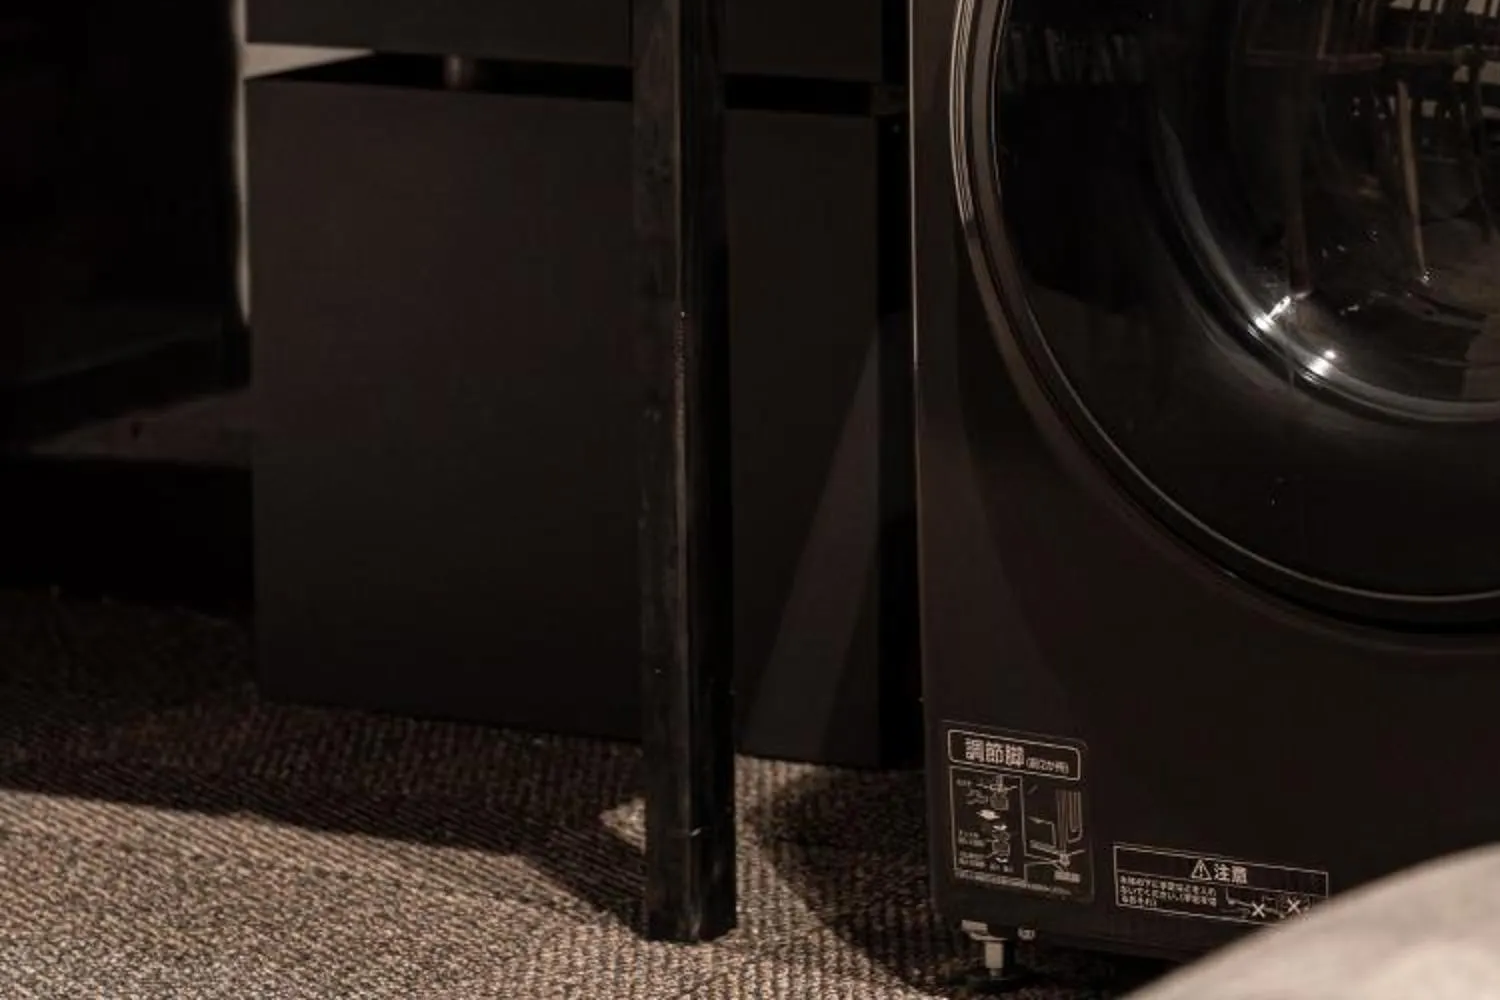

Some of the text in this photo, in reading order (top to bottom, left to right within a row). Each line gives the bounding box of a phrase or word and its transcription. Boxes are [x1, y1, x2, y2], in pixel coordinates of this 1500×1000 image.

[964, 738, 1025, 767] 調節脚
[1213, 863, 1248, 885] 注意
